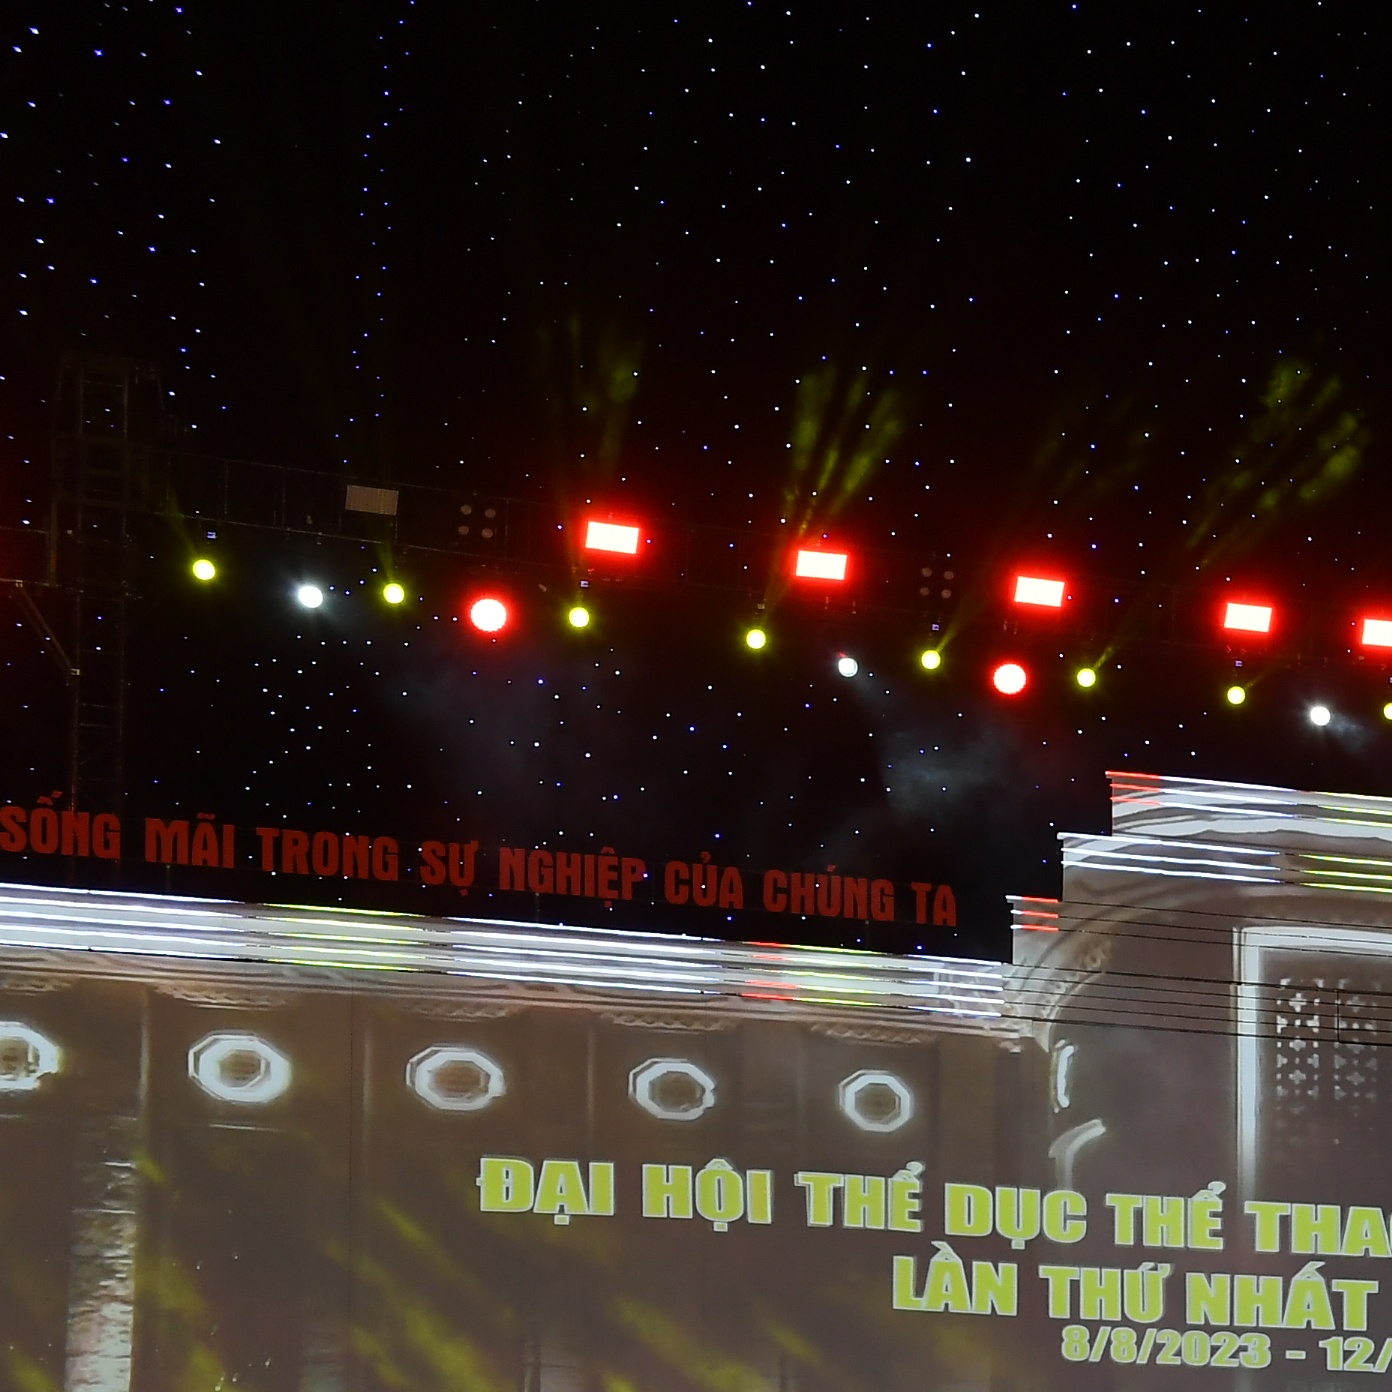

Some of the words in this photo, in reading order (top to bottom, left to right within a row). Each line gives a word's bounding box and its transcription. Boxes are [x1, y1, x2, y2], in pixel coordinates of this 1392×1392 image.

[0, 791, 121, 859] SỐNG
[145, 810, 235, 869] MÃI
[257, 826, 398, 882] TRONG
[420, 840, 479, 897] SỰ
[499, 846, 648, 910] NGHIỆP
[664, 850, 743, 910] CỦA
[762, 864, 895, 922] CHÚNG
[913, 882, 957, 927] TA
[477, 1157, 615, 1225] ĐẠI
[642, 1158, 772, 1231] HỘI
[795, 1161, 923, 1232] THỂ
[944, 1183, 1087, 1250] DỤC
[1105, 1182, 1226, 1250] THỂ
[893, 1241, 1018, 1316] LẦN
[1039, 1262, 1172, 1323] THỨ
[1186, 1261, 1378, 1331] NHẤT
[1061, 1325, 1272, 1368] 8/8/2023
